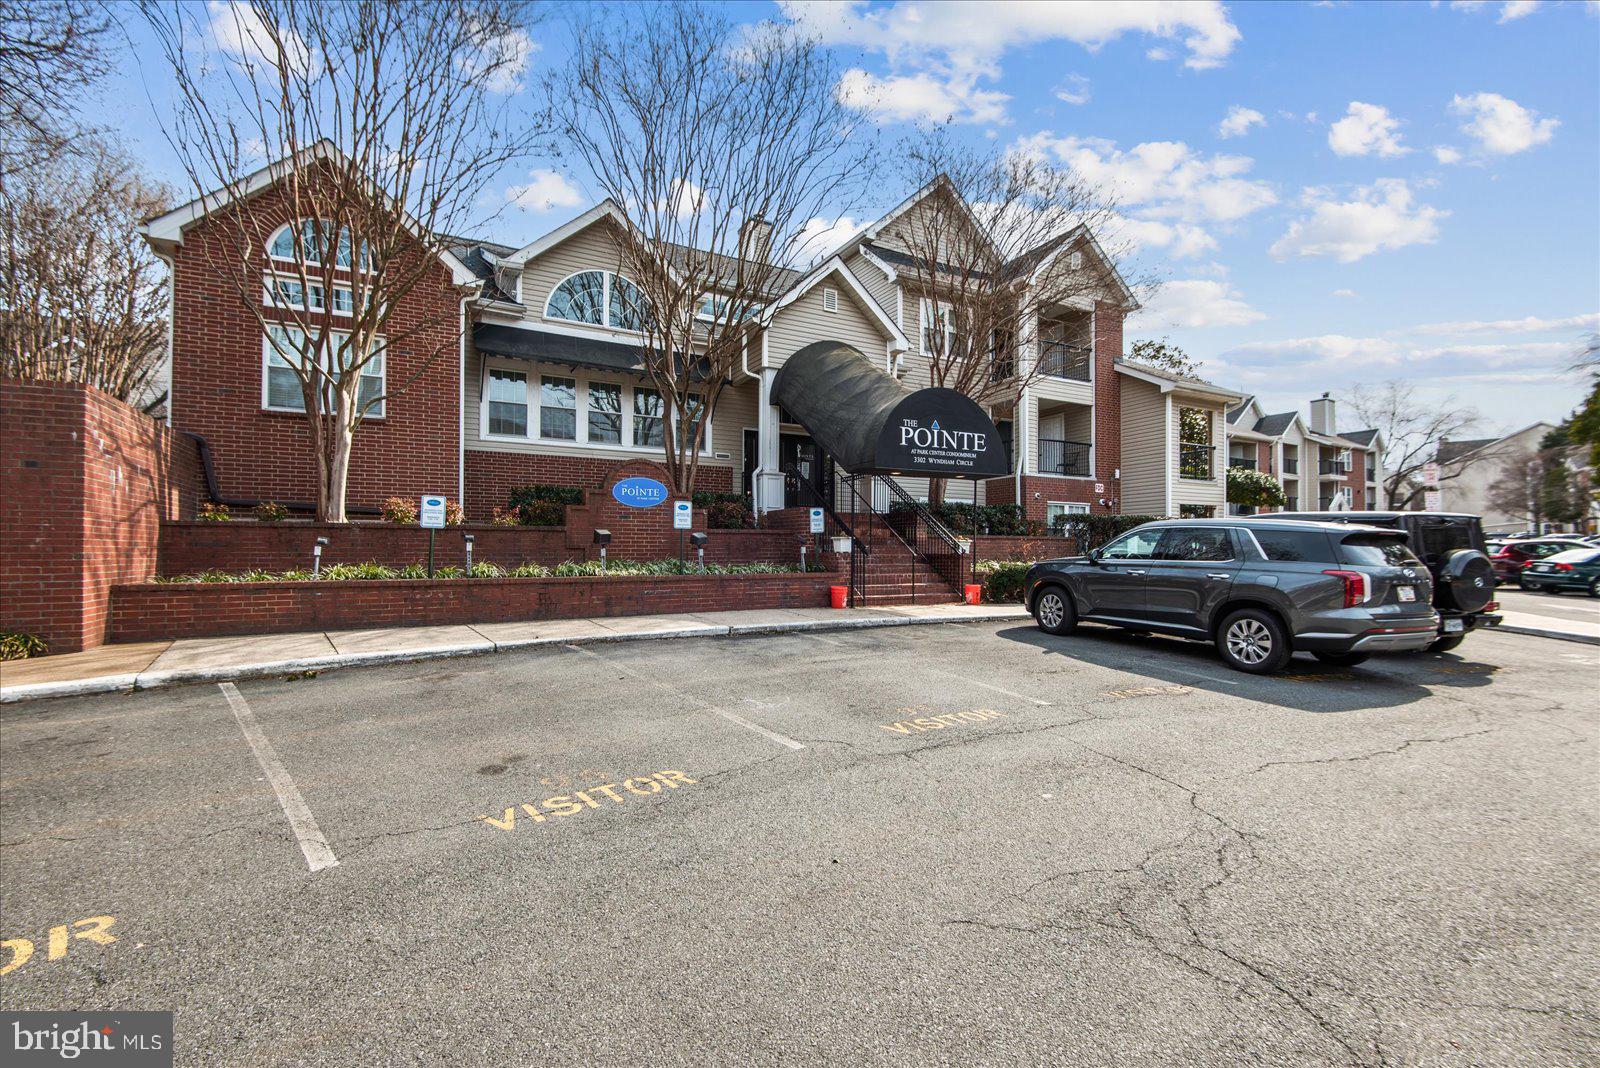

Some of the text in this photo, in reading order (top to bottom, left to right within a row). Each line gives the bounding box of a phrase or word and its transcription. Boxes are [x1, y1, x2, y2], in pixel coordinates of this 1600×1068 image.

[903, 418, 918, 427] THE
[899, 425, 987, 452] POINTE
[928, 457, 955, 465] WYNDHAM
[621, 485, 660, 496] POINTE
[878, 709, 1001, 734] VISITOR
[475, 769, 698, 831] VISITOR
